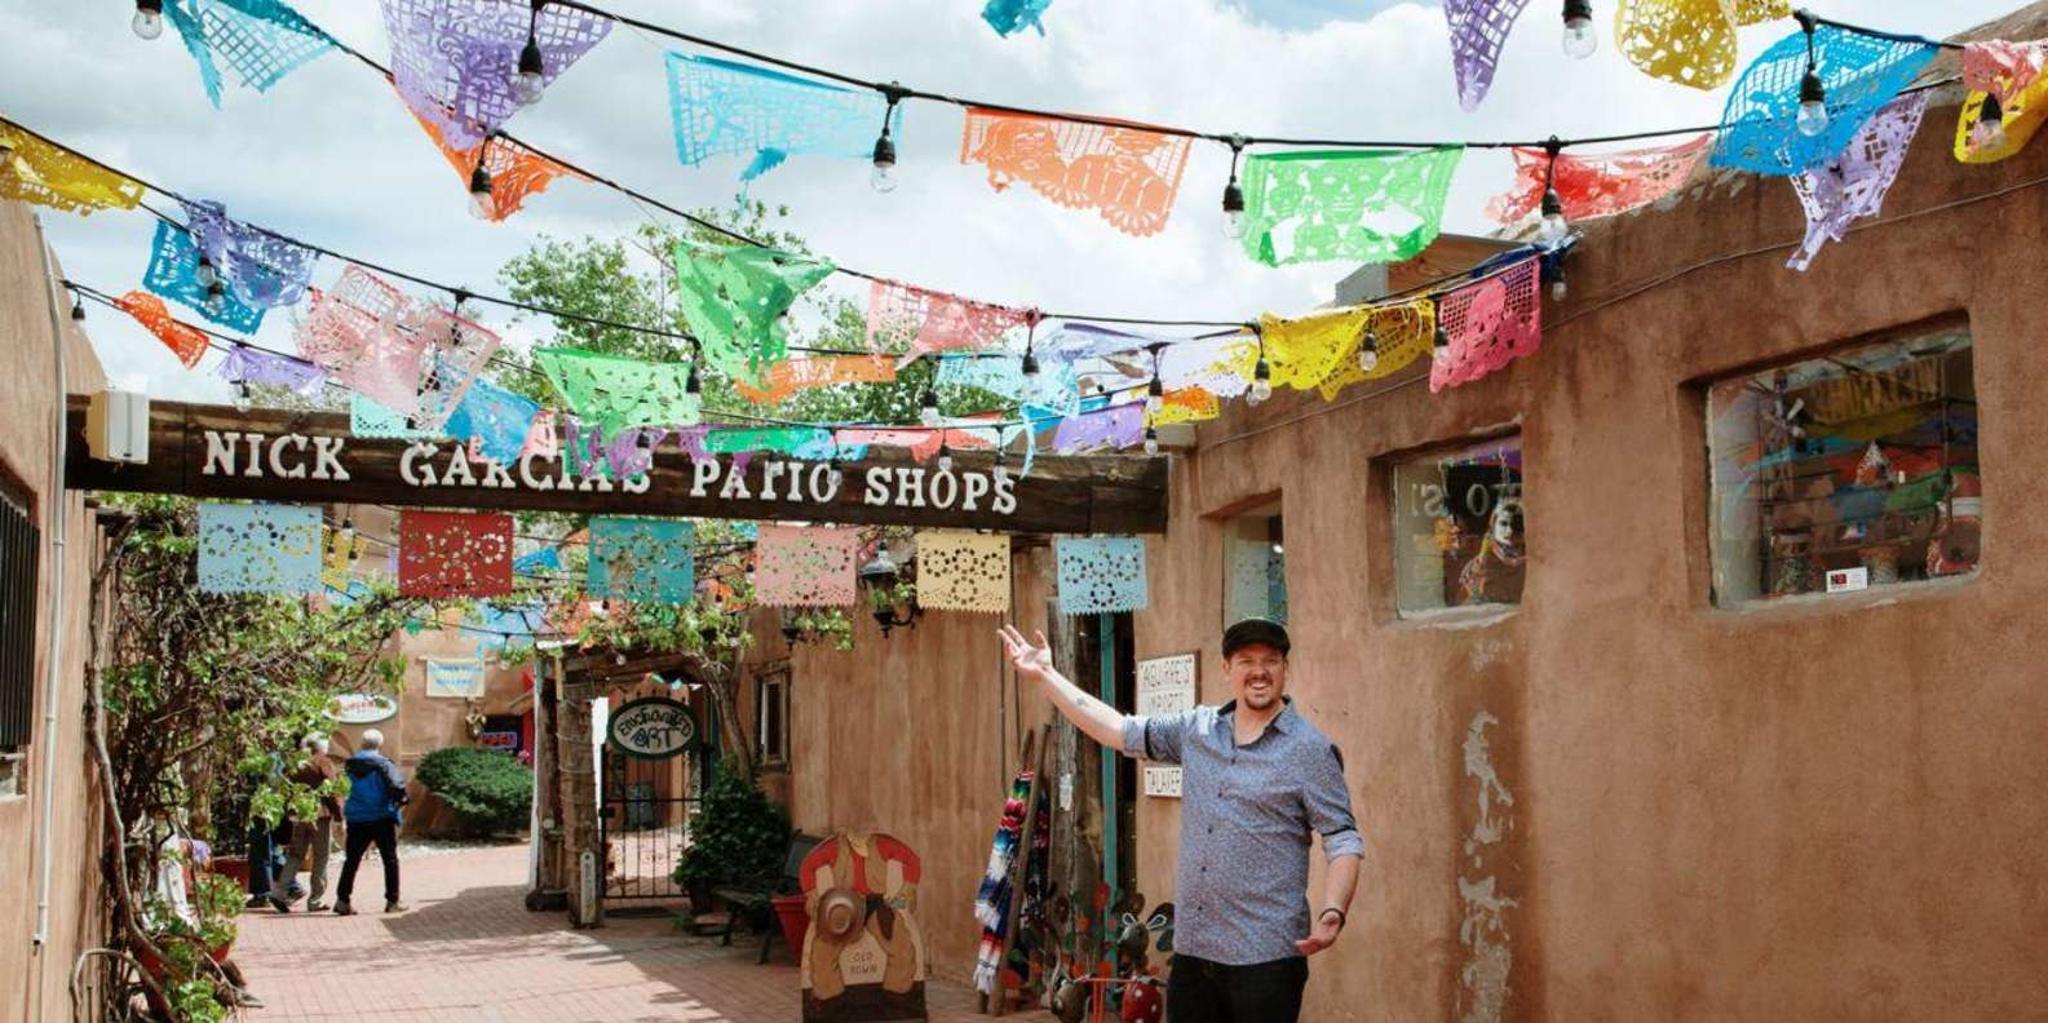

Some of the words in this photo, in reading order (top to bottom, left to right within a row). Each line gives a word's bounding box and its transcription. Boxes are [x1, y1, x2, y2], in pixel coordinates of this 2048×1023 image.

[202, 431, 350, 481] NICK
[690, 458, 838, 502] PATIO
[864, 466, 1017, 515] SHOPS
[630, 727, 682, 749] ART
[853, 952, 874, 962] OLD
[849, 965, 878, 975] TOWN
